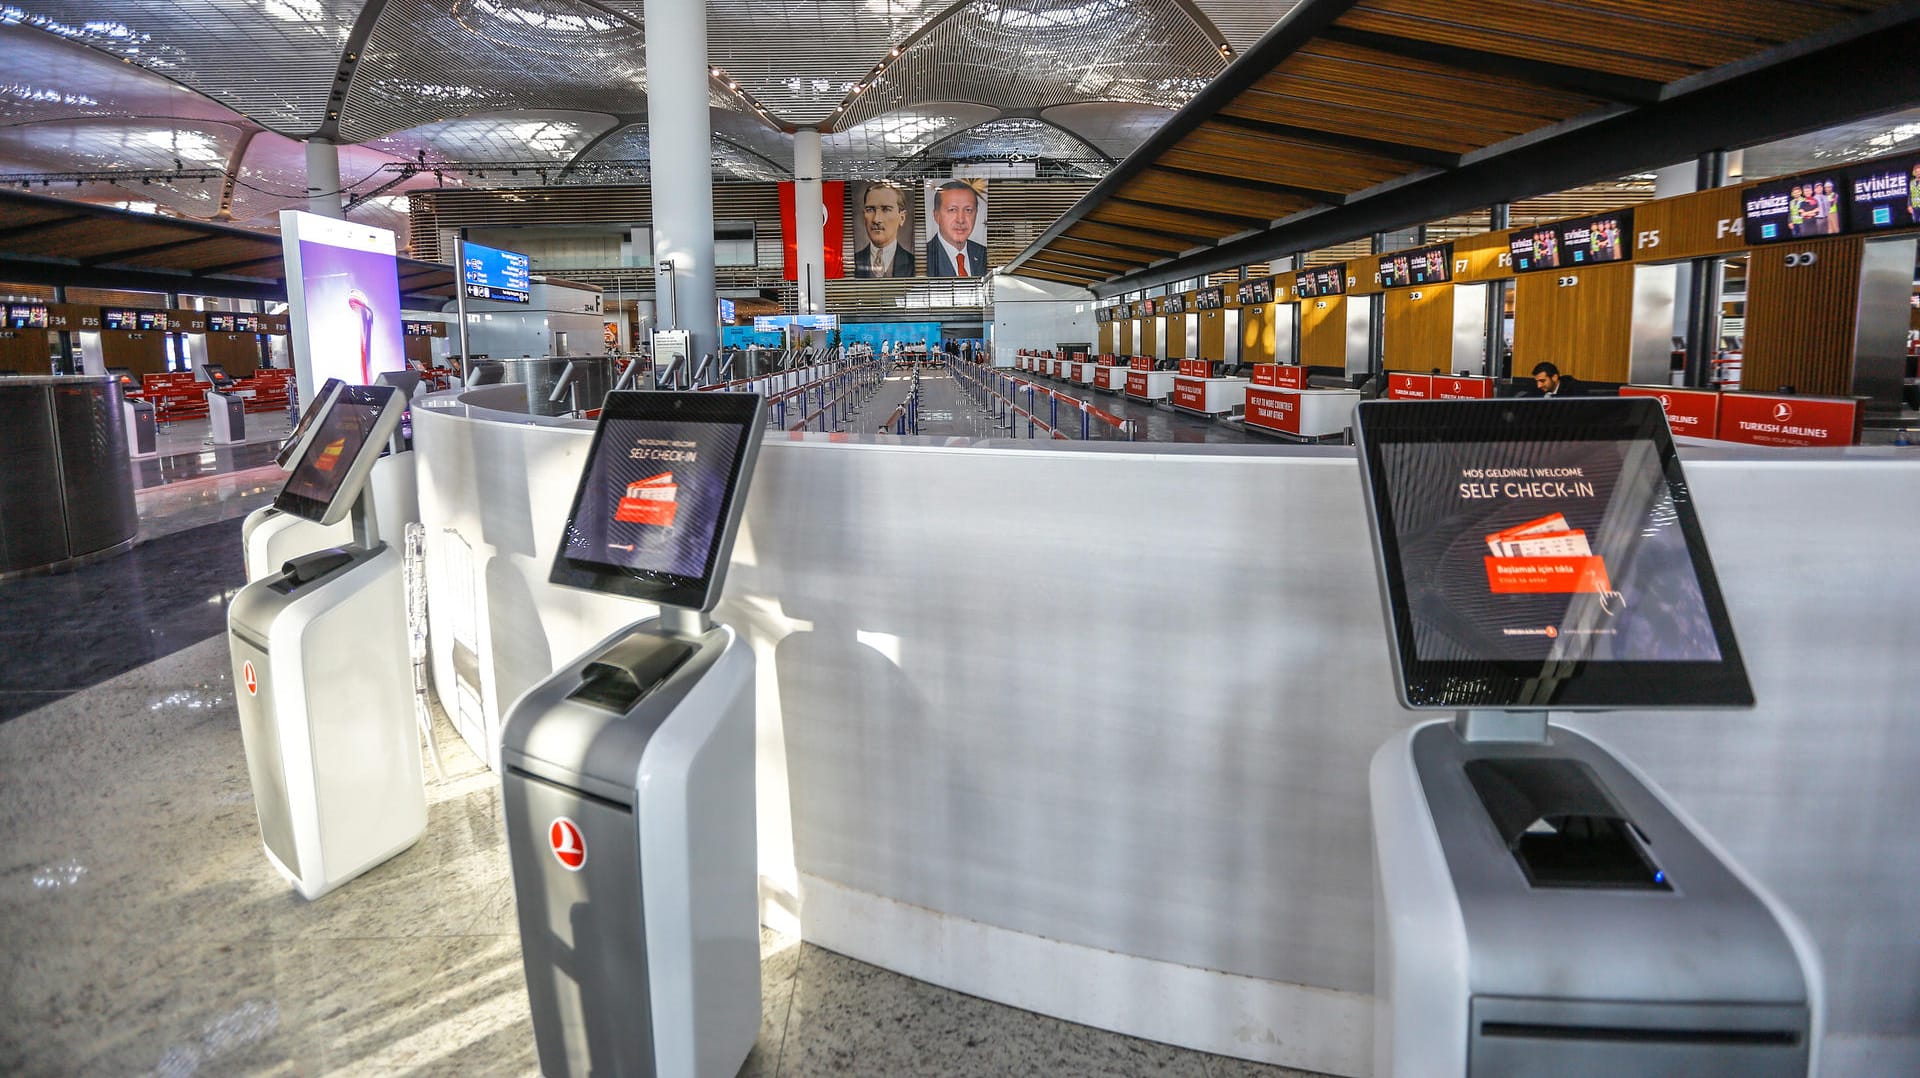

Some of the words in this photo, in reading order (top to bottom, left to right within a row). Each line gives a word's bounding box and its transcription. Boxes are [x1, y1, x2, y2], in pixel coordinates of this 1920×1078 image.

[1717, 217, 1743, 239] F4
[1638, 230, 1659, 249] F5
[1455, 259, 1468, 273] F7
[1499, 253, 1512, 267] F6
[595, 295, 600, 312] F
[49, 316, 66, 326] F34
[82, 317, 100, 326] F35
[191, 320, 204, 329] F37
[1739, 421, 1780, 434] TURKISH
[1781, 426, 1828, 439] AIRLINES
[1462, 468, 1484, 479] HOŞ
[1535, 467, 1584, 478] WELCOME
[1460, 483, 1499, 498] SELF
[1503, 481, 1595, 498] CHECK-IN
